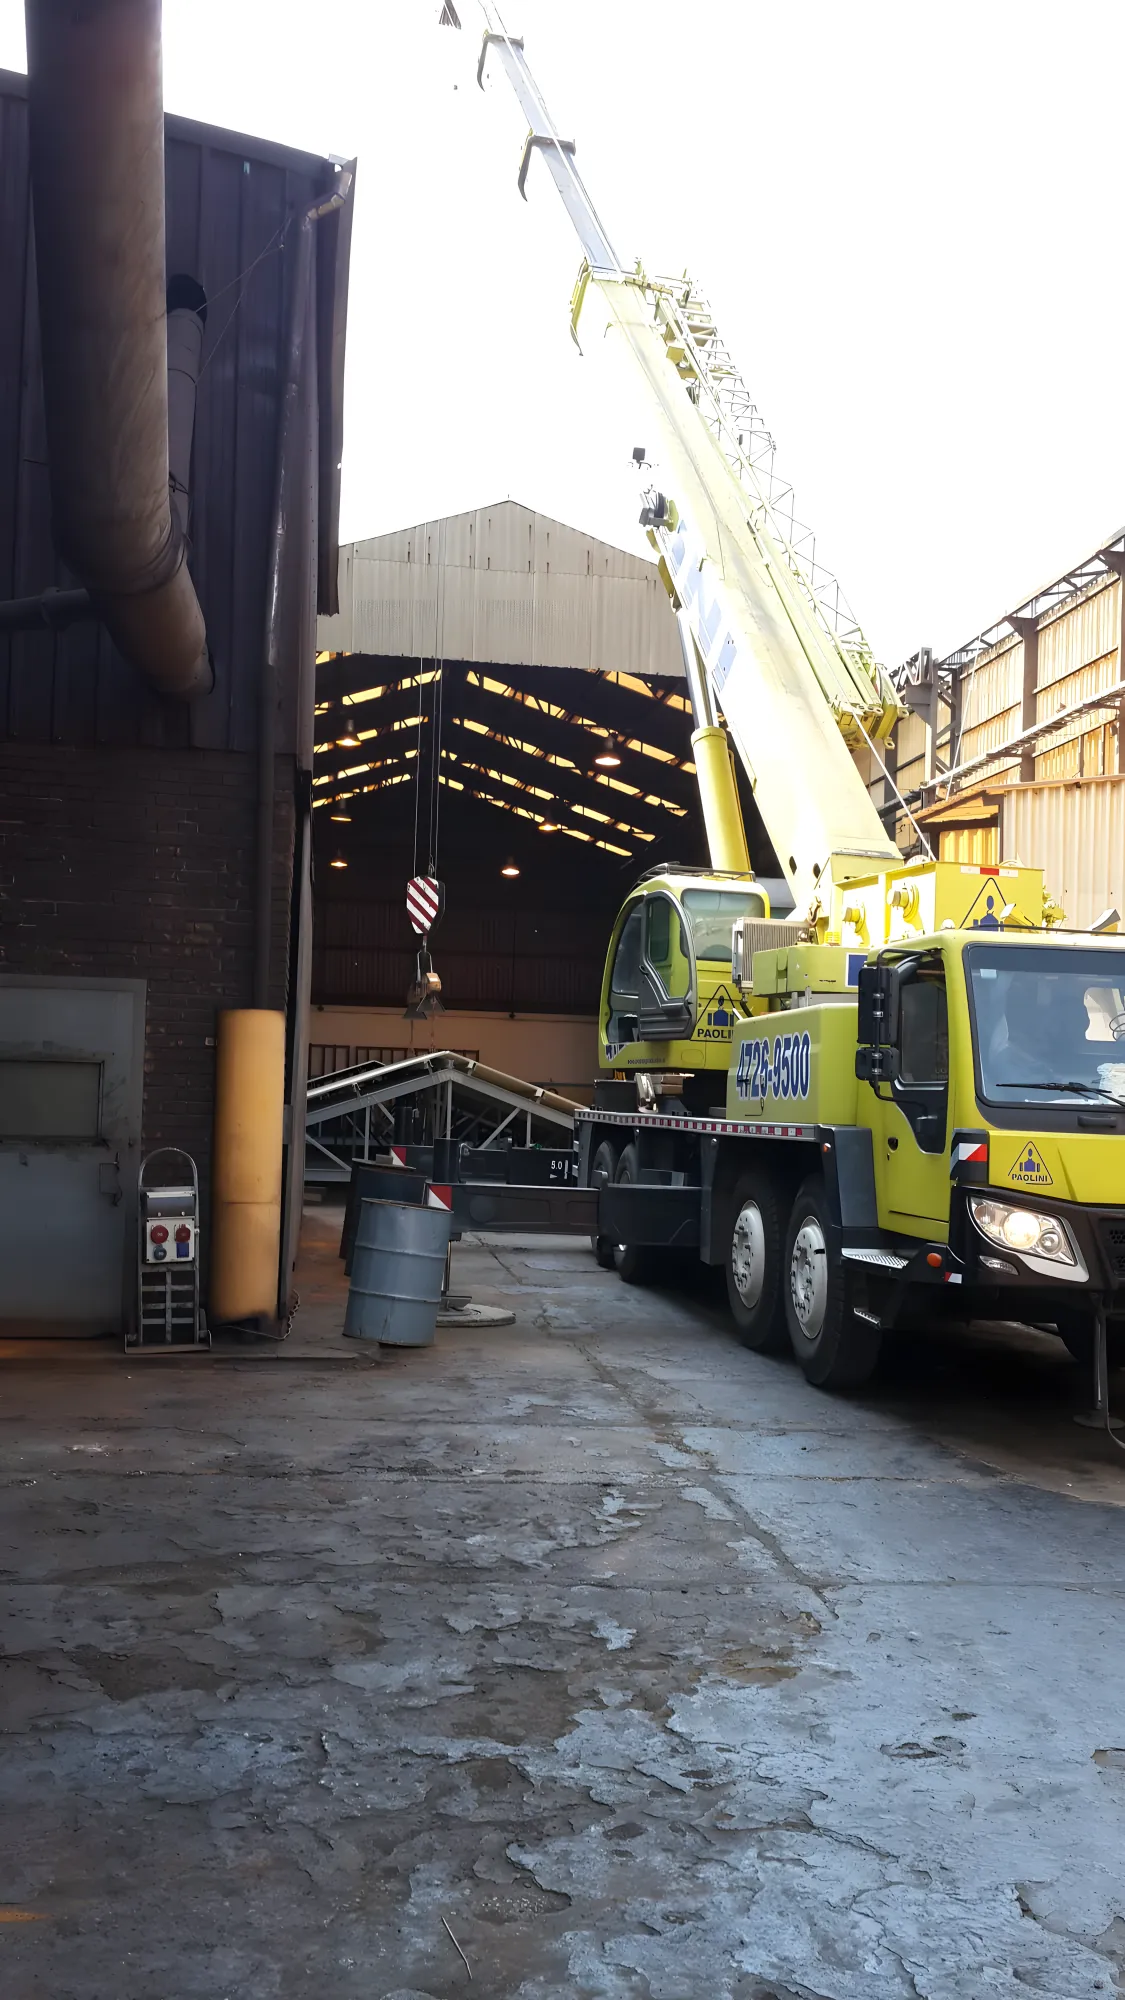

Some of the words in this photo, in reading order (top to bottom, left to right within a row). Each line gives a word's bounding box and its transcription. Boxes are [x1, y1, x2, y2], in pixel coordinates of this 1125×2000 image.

[736, 1031, 811, 1100] 4726-9500
[551, 1160, 563, 1170] 5.0
[1011, 1173, 1048, 1182] PAOLINI
